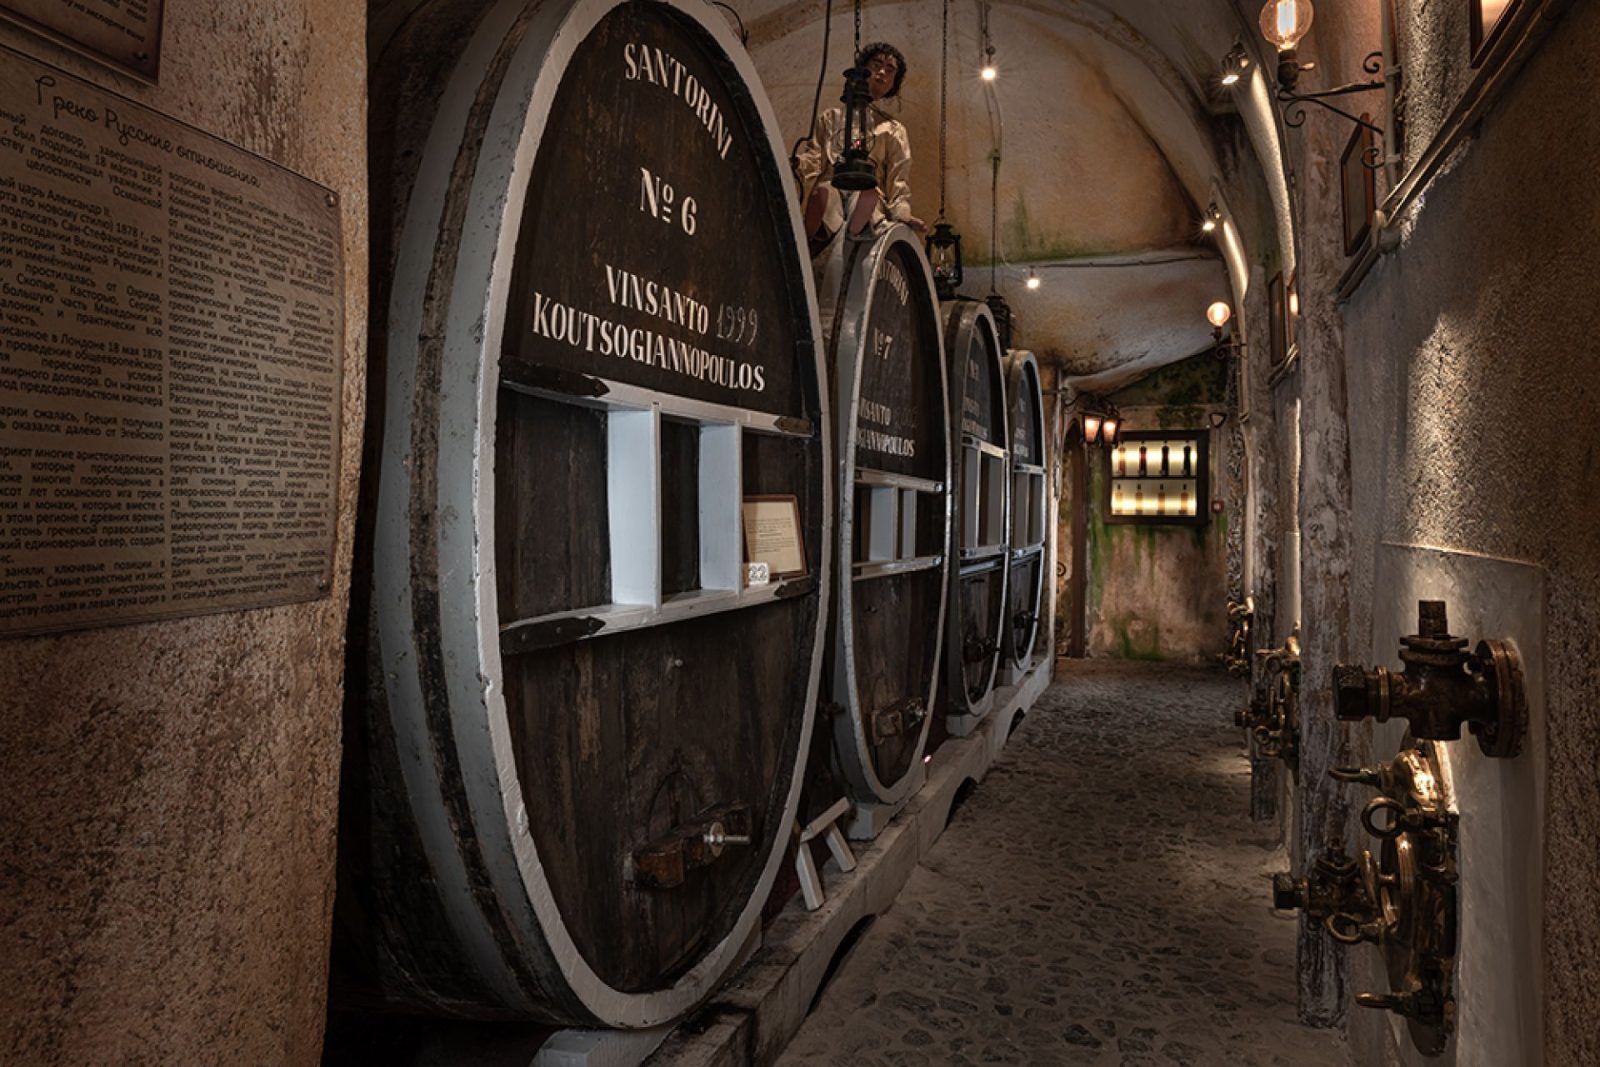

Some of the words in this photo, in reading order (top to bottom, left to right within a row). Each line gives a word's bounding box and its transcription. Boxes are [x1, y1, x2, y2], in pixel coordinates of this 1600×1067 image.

[35, 74, 99, 122] Греко
[104, 107, 175, 154] Русские
[624, 42, 734, 161] SANTORINI
[680, 194, 698, 237] 6
[605, 264, 709, 336] VINSANTO
[532, 291, 766, 393] KOUTSOGIANNOPOULOS
[884, 335, 893, 360] 7
